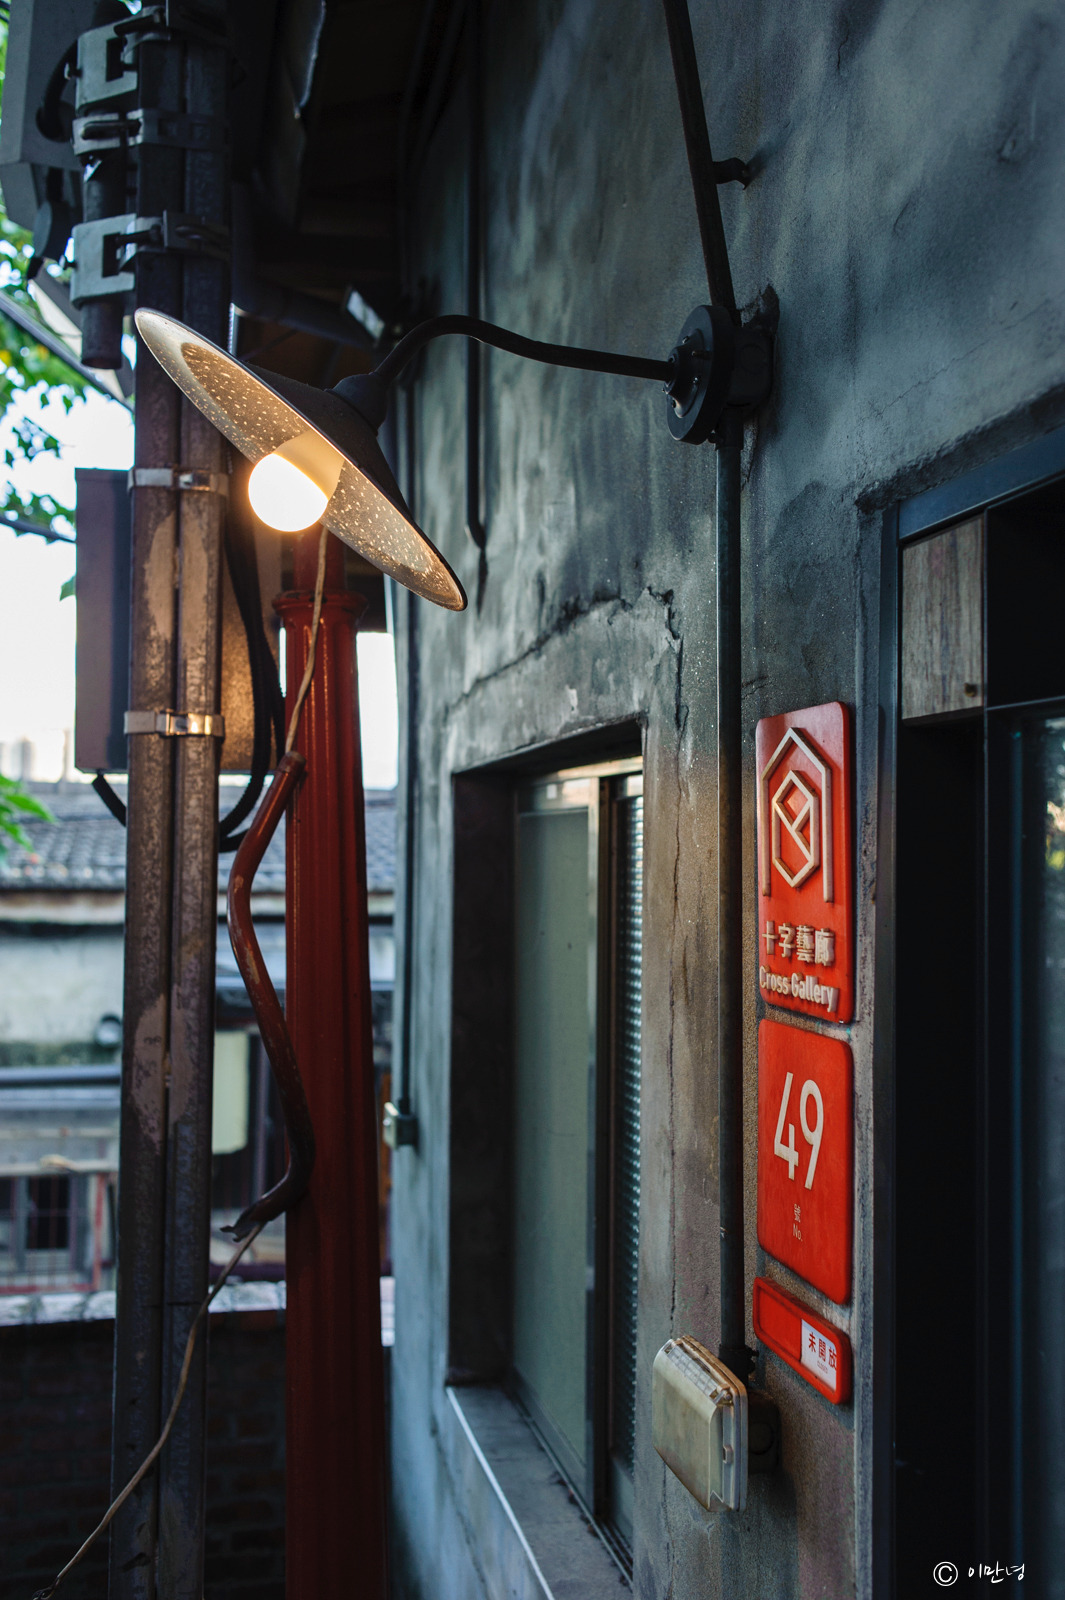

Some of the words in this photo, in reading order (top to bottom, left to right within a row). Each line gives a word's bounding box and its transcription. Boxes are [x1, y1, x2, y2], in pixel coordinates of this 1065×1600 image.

[762, 920, 835, 967] 十字藝廊
[760, 965, 790, 995] Cross
[791, 972, 839, 1012] Gallery
[774, 1072, 824, 1190] 49
[793, 1223, 803, 1242] No.
